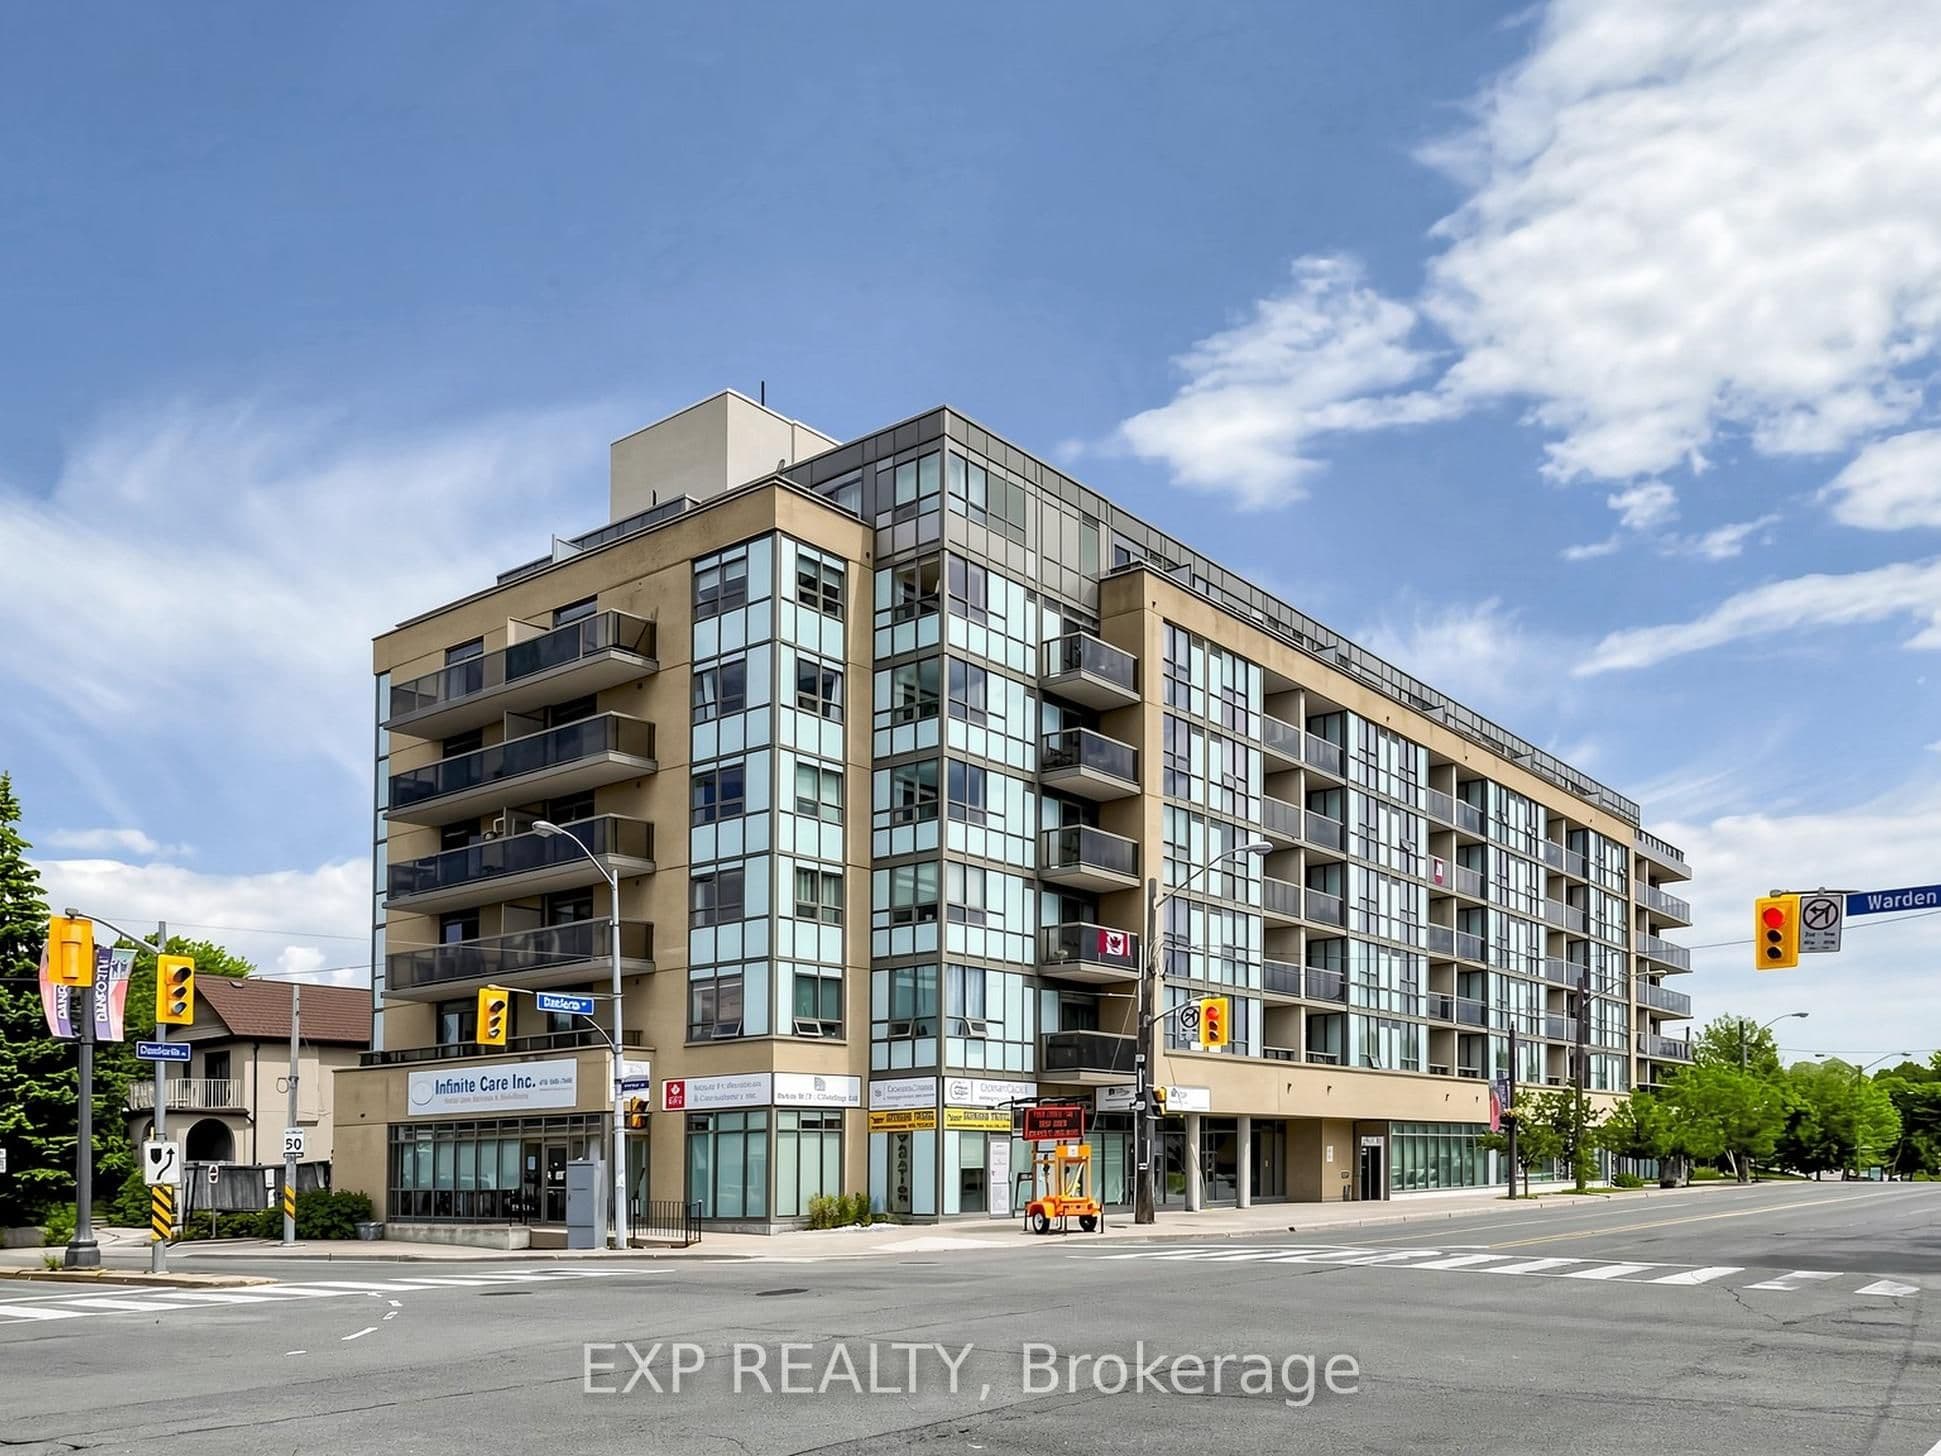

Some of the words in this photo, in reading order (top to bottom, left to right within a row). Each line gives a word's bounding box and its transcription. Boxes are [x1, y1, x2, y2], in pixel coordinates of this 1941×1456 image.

[1867, 890, 1937, 911] Warden
[435, 1078, 476, 1095] Infinite
[480, 1075, 508, 1092] Care
[512, 1073, 536, 1089] Inc.
[285, 1137, 302, 1150] 50
